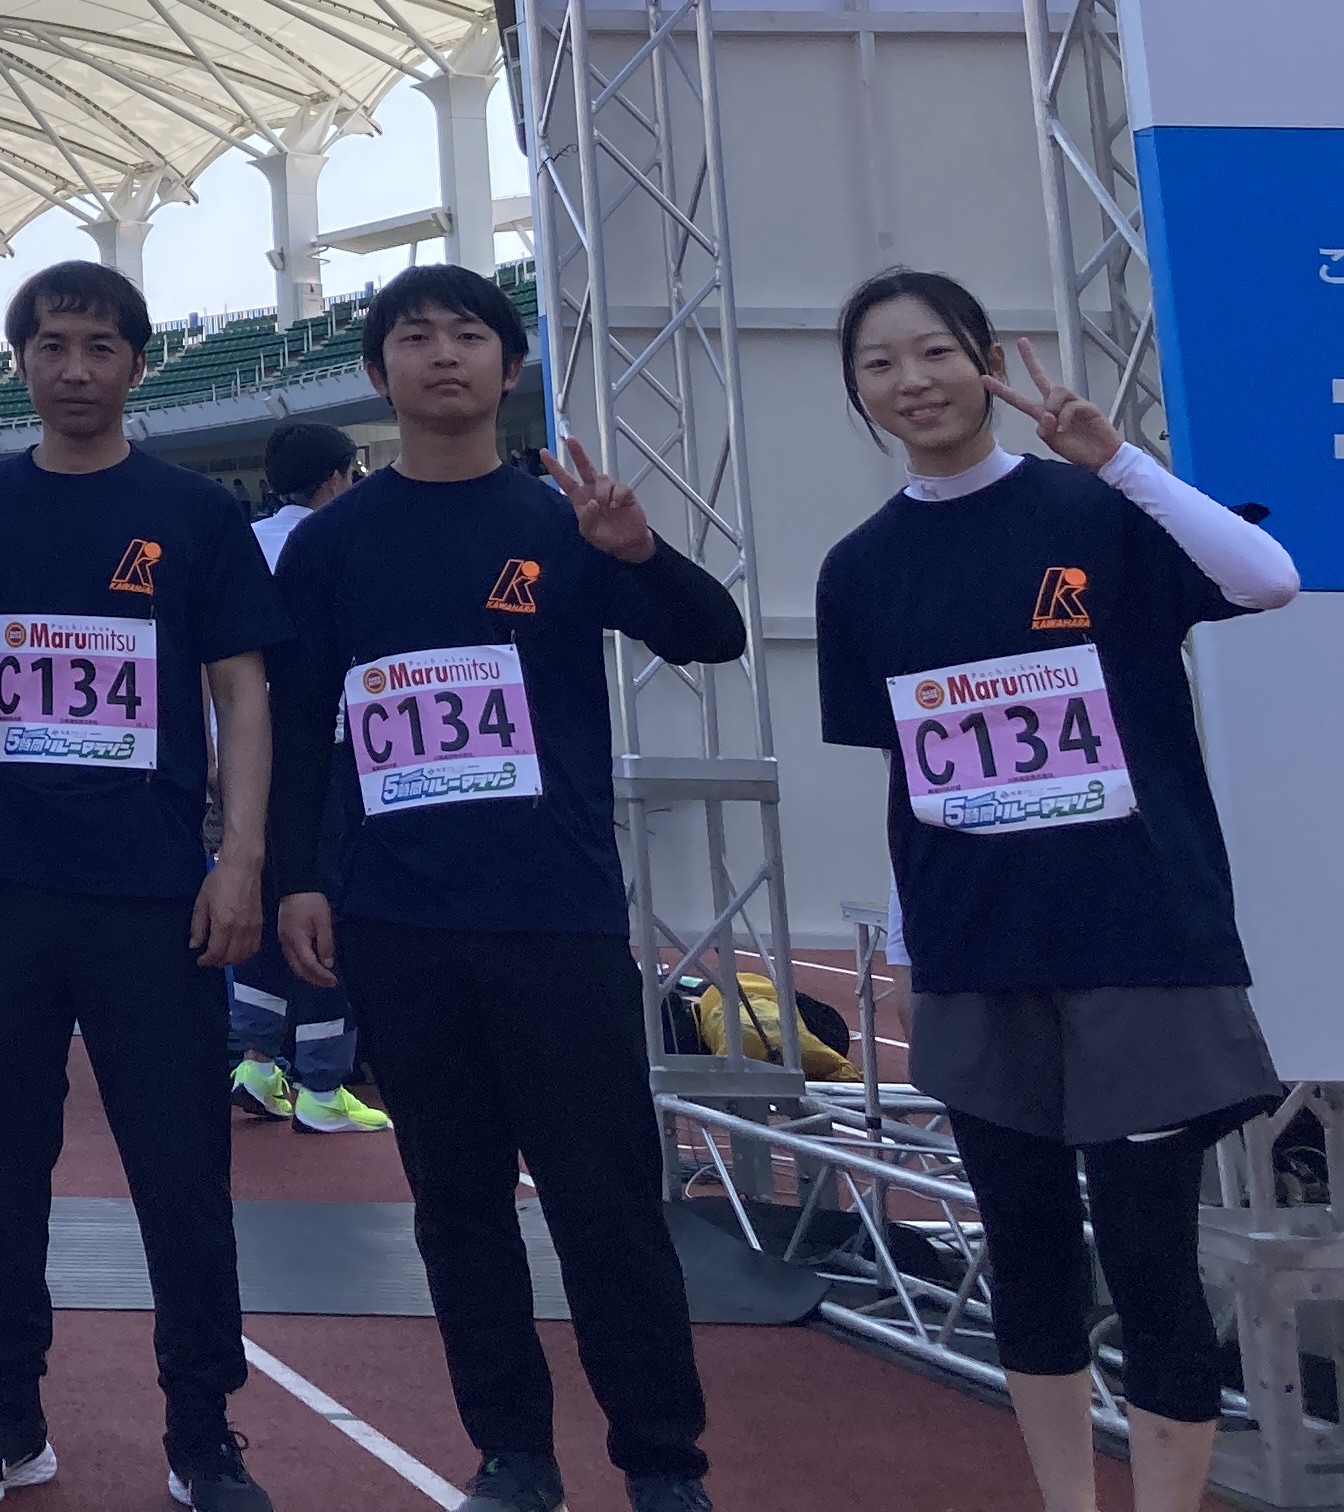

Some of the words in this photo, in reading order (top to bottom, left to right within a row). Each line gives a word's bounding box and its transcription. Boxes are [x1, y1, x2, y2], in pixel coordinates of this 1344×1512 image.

[29, 622, 136, 652] Marumitsu
[388, 658, 500, 690] Marumitsu
[946, 665, 1079, 705] Marumitsu
[363, 688, 516, 764] C134
[915, 697, 1102, 786] C134
